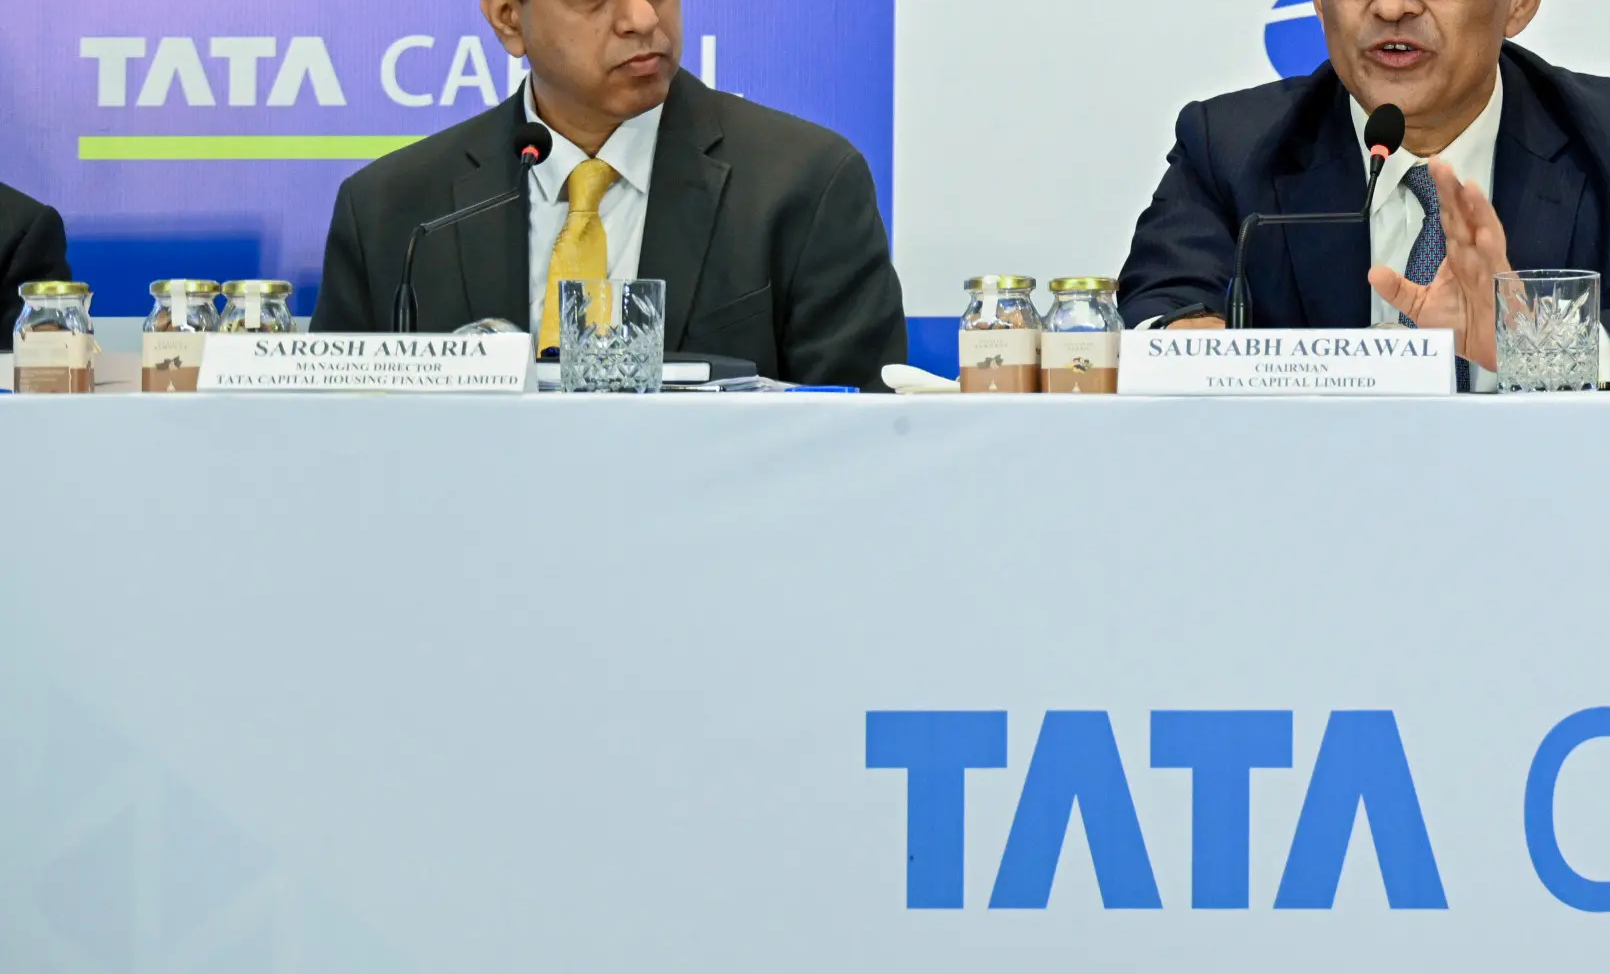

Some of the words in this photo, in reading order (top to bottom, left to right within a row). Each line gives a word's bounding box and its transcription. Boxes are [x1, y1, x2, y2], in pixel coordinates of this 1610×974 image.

[79, 36, 346, 107] TATA
[254, 339, 366, 356] SAROSH
[374, 340, 487, 356] AMARIA
[1148, 338, 1283, 356] SAURABH
[1291, 338, 1438, 356] AGRAWAL
[296, 362, 369, 371] MANAGING
[373, 362, 442, 372] DIRECTOR
[1254, 363, 1328, 373] CHAIRMAN
[216, 375, 253, 385] TATA
[257, 375, 320, 385] CAPITAL
[323, 375, 387, 385] HOUSING
[392, 375, 453, 386] FINANCE
[458, 375, 519, 386] LIMITED
[1206, 377, 1244, 387] TATA
[1248, 377, 1310, 387] CAPITAL
[1315, 377, 1376, 387] LIMITED
[866, 710, 1448, 909] TATA
